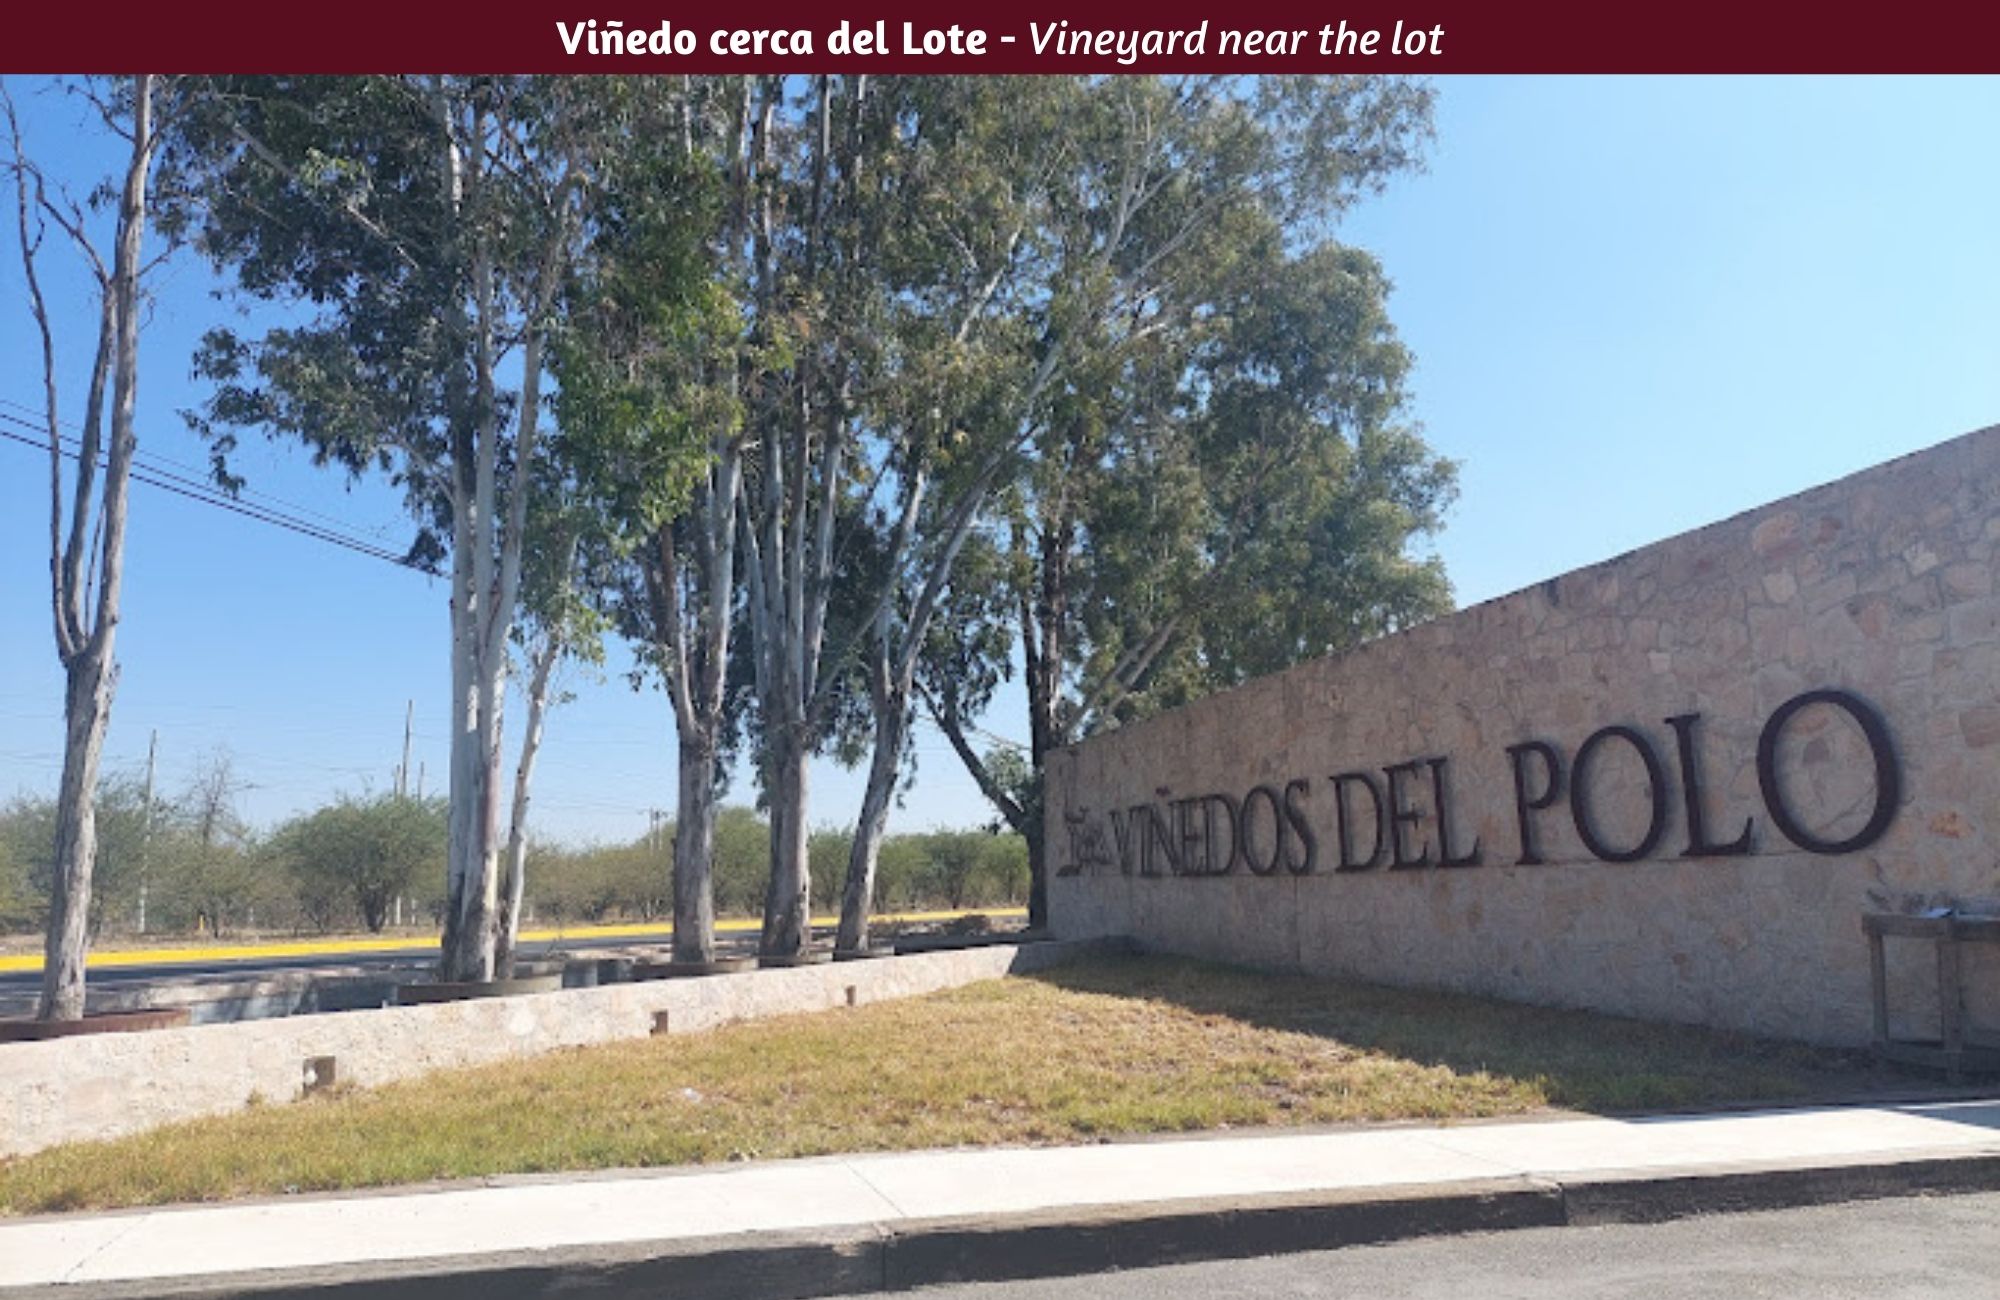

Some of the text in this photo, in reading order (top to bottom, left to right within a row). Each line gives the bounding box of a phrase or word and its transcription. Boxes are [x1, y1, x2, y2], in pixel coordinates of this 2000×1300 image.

[1109, 689, 1902, 877] VIÑEDOS DEL POLO
